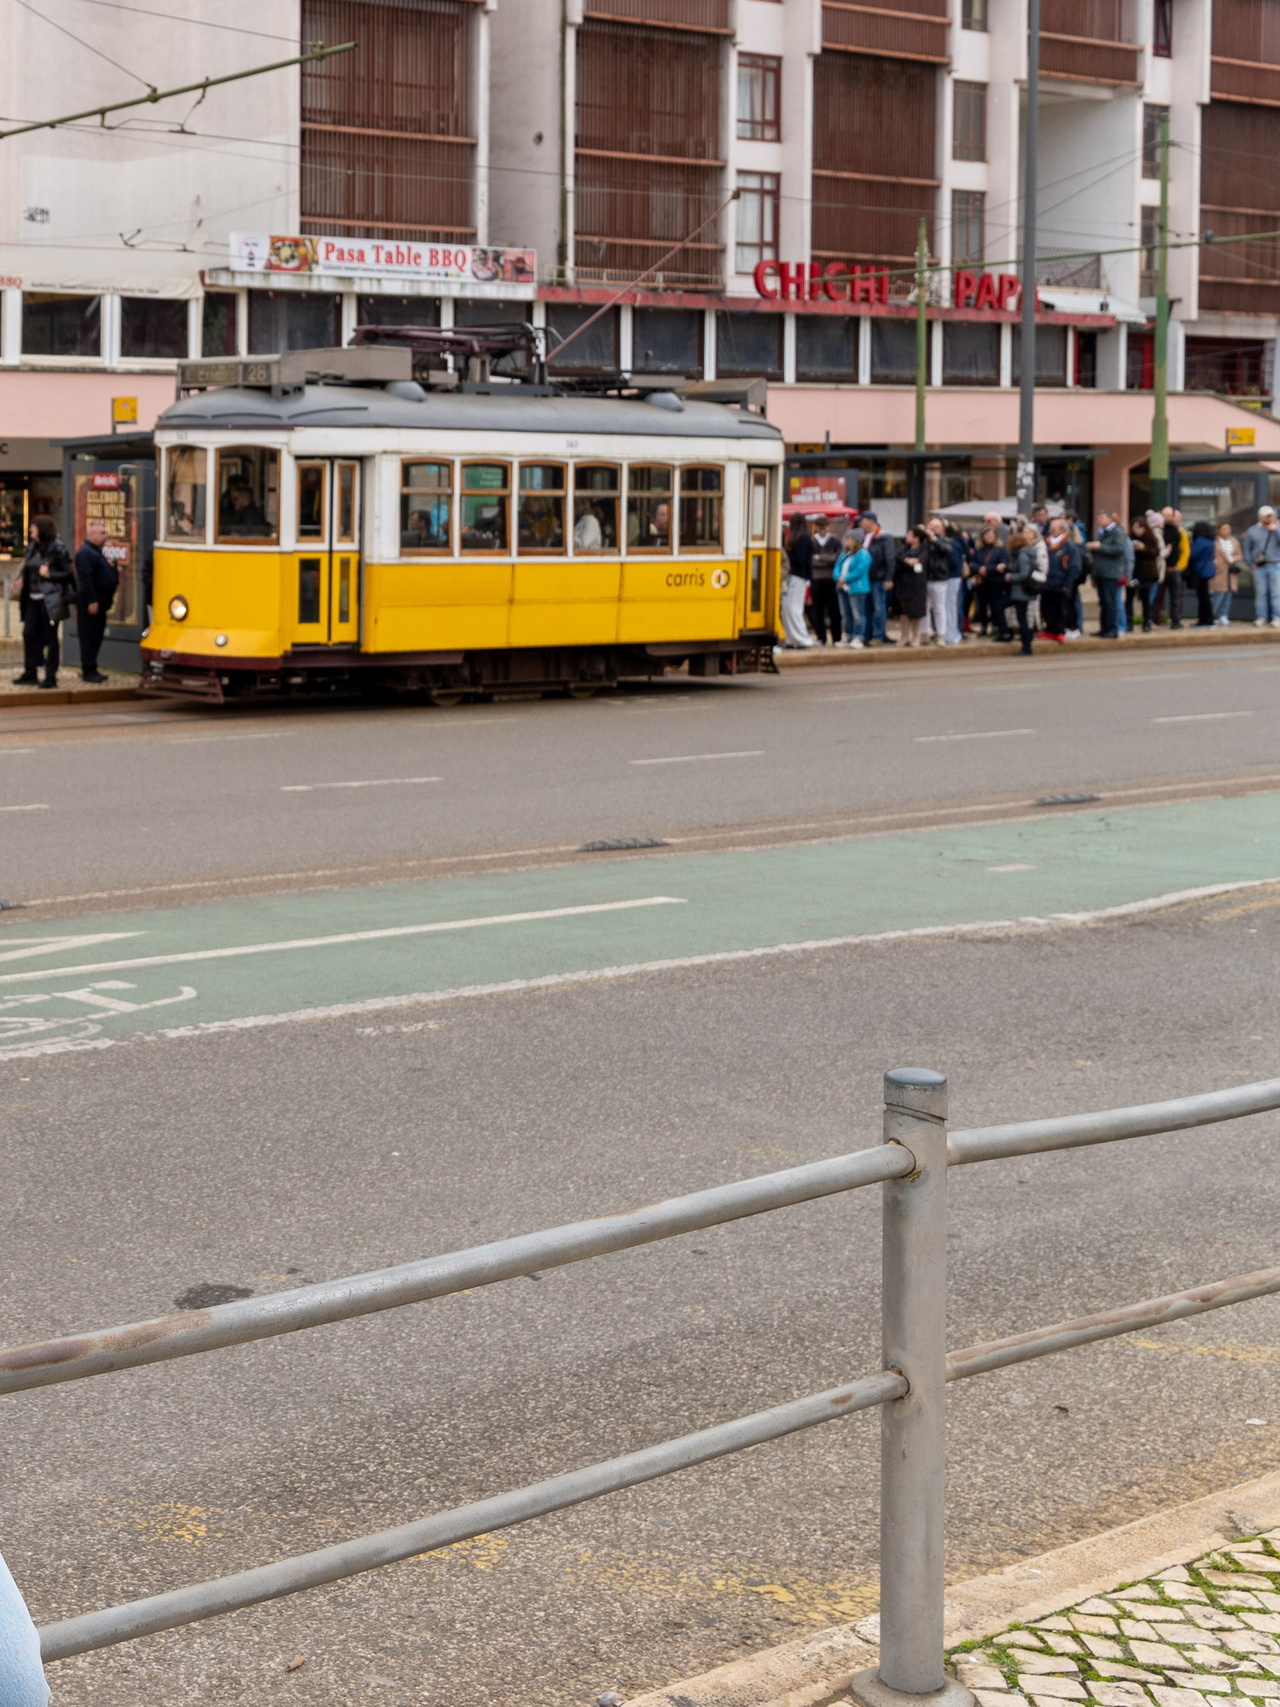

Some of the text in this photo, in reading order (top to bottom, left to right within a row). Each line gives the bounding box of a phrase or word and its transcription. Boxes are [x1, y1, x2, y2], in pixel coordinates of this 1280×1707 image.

[324, 242, 366, 262] Pasa
[371, 244, 422, 265] Table
[429, 247, 467, 272] BBQ
[753, 259, 890, 305] CHICHI
[247, 363, 267, 382] 28
[665, 569, 705, 587] carris
